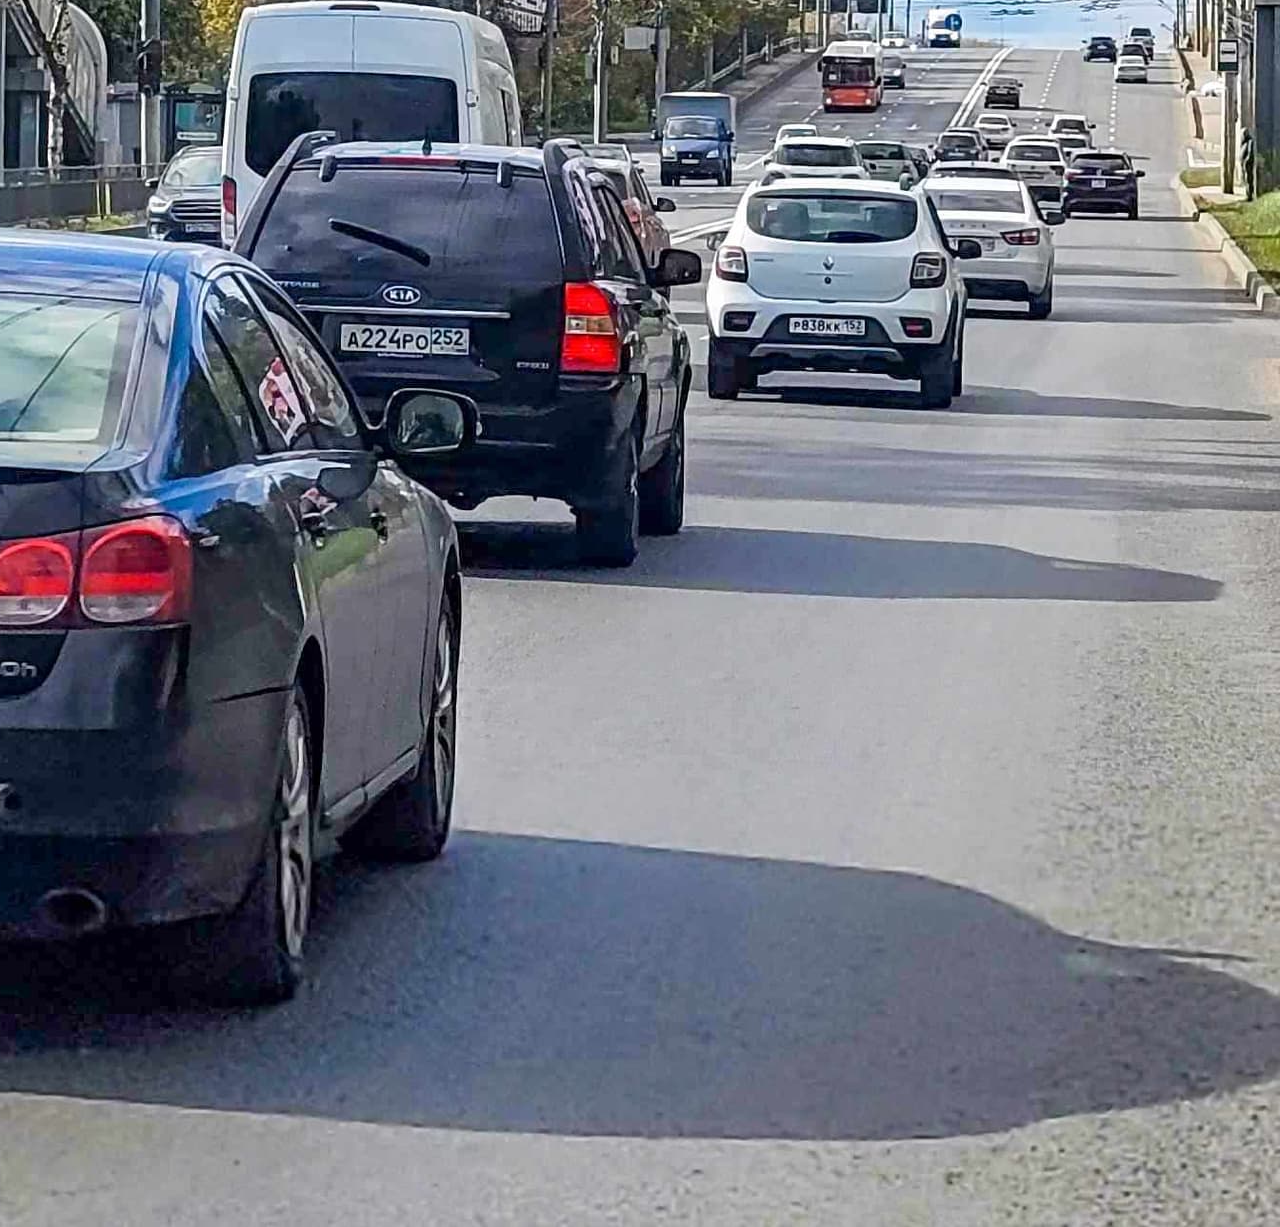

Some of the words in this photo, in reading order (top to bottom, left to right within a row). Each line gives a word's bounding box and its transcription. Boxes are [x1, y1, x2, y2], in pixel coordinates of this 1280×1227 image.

[389, 289, 414, 301] KIA
[347, 327, 429, 351] А224РО
[432, 329, 464, 346] 252
